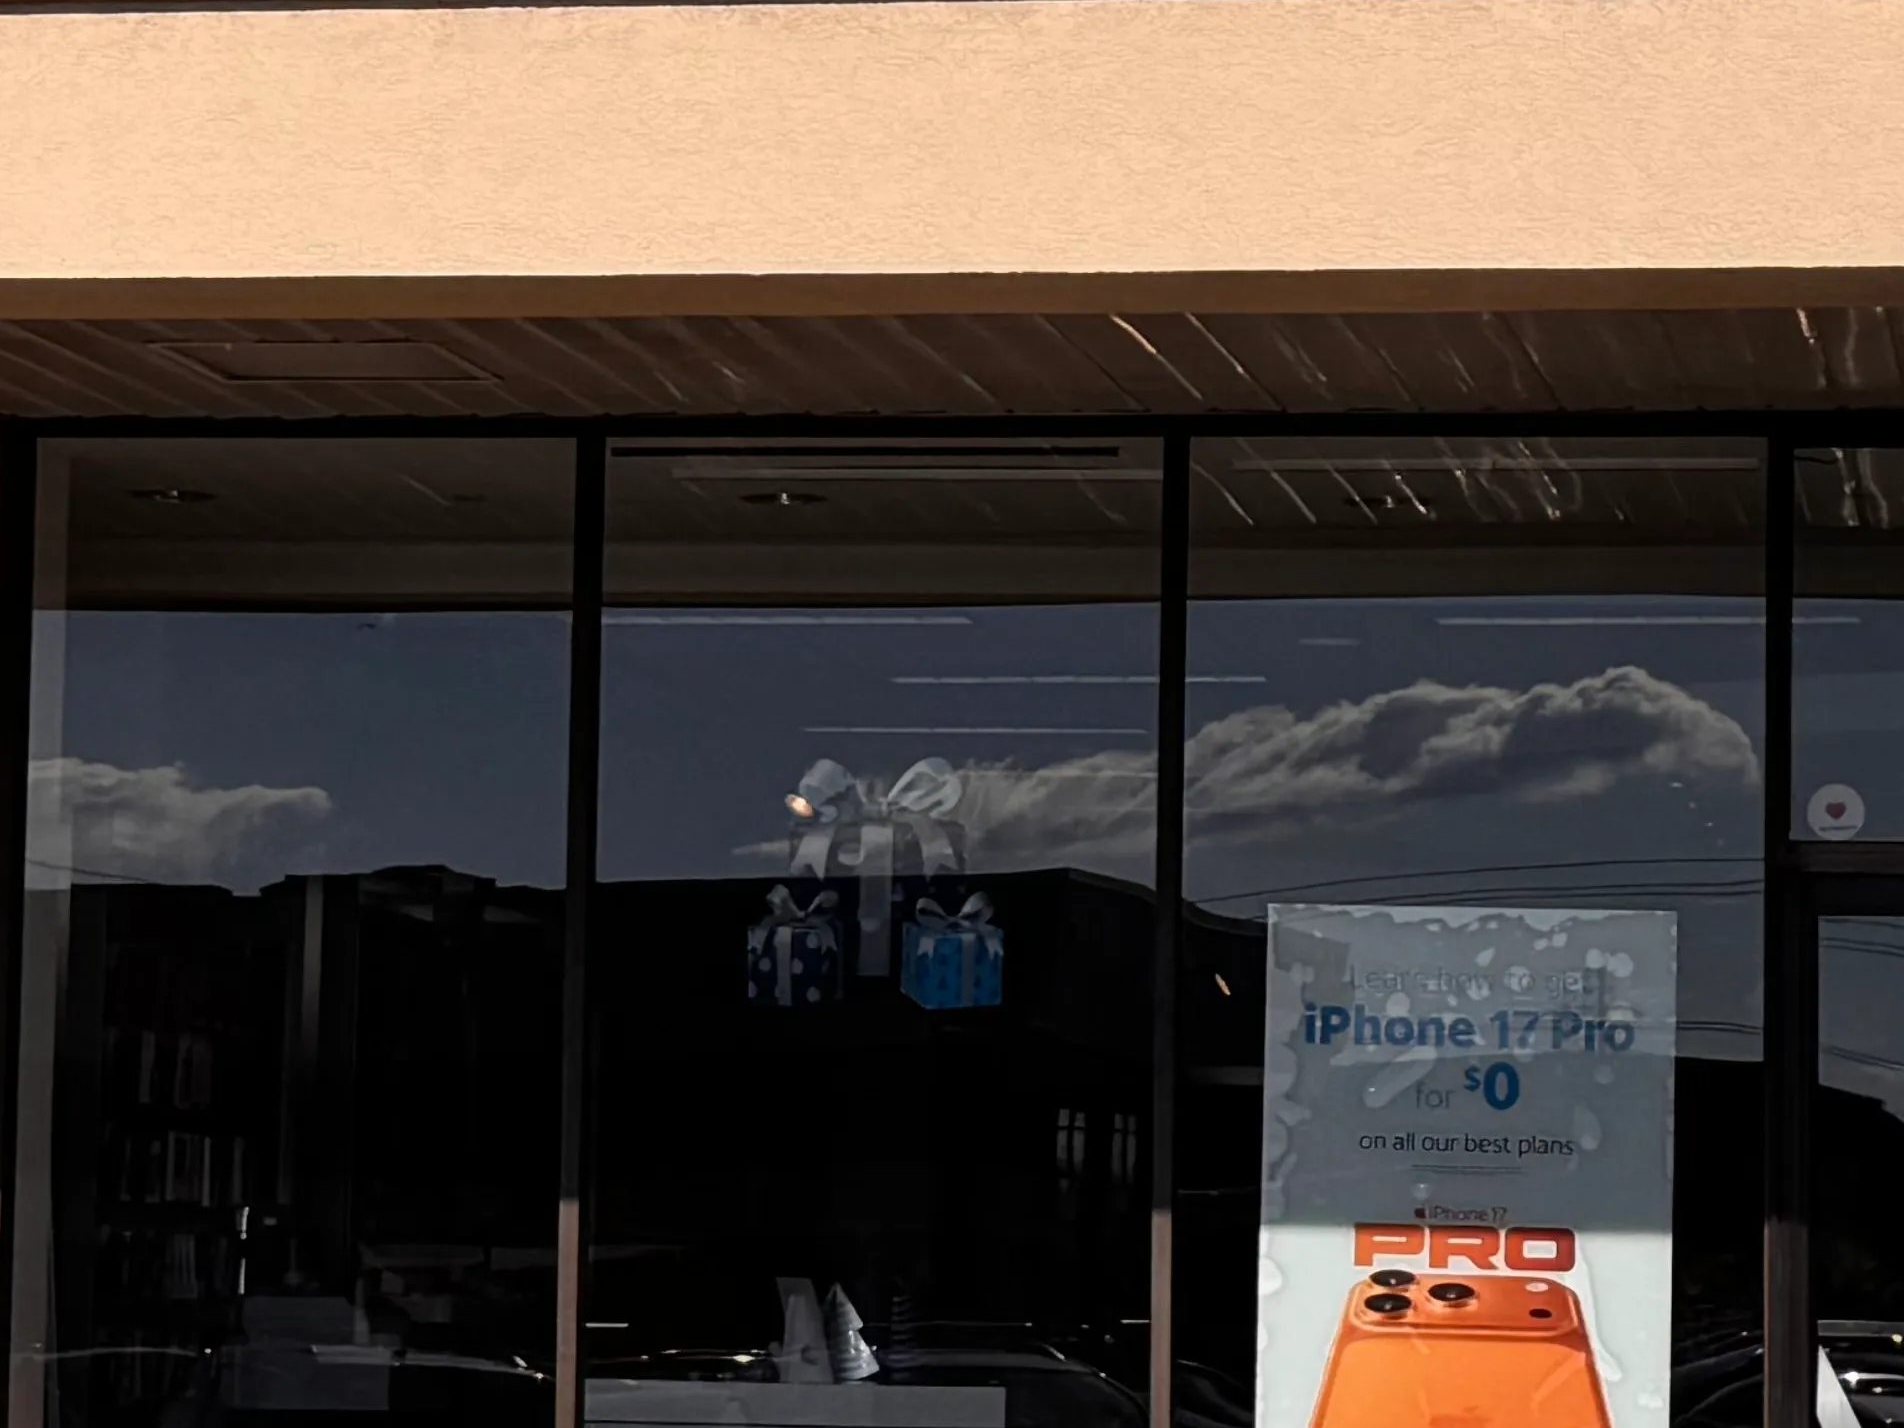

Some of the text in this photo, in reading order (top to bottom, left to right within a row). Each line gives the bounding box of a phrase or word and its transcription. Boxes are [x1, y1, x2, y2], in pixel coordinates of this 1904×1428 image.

[1304, 1002, 1635, 1053] iPhone 17 Pro
[1416, 1061, 1521, 1112] for $0
[1359, 1132, 1574, 1159] on all our best plans
[1428, 1204, 1489, 1221] iPhone
[1353, 1223, 1576, 1272] PRO
